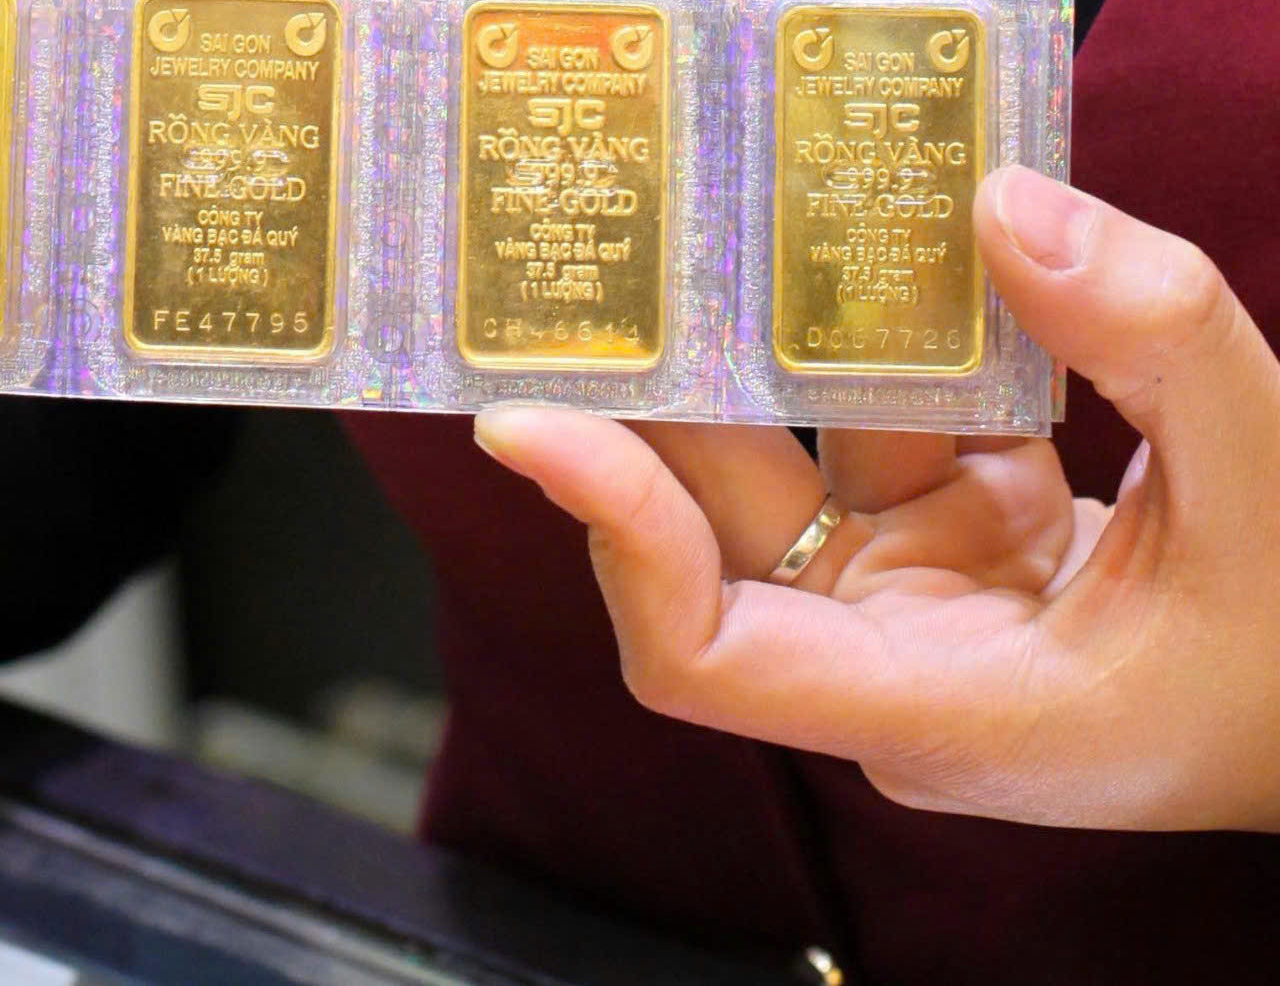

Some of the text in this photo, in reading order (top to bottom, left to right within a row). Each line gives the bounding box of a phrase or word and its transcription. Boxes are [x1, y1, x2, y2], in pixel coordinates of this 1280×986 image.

[200, 33, 272, 54] SAI GON
[150, 56, 320, 81] JEWELRY COMPANY
[527, 47, 600, 70] SAI GON
[844, 52, 915, 72] SAI GON
[562, 72, 647, 95] COMPANY
[795, 76, 964, 98] JEWELRY COMPANY
[197, 83, 276, 120] SJC
[527, 98, 607, 136] SJC
[843, 103, 920, 139] SJC
[239, 118, 320, 149] VÀNG
[567, 131, 650, 163] VÀNG
[884, 137, 967, 165] VÀNG
[230, 176, 307, 202] GOLD
[559, 189, 638, 216] GOLD
[876, 194, 954, 219] GOLD
[197, 205, 264, 227] CÔNG TY
[162, 224, 204, 243] VÀNG
[267, 226, 299, 247] QUÝ
[529, 218, 596, 241] CÔNG TY
[847, 222, 912, 243] CÔNG TY
[193, 248, 265, 267] 37.5 gram
[495, 237, 537, 260] VÀNG
[598, 237, 632, 262] QUÝ
[526, 262, 556, 279] 37.5
[153, 310, 308, 333] FE47795
